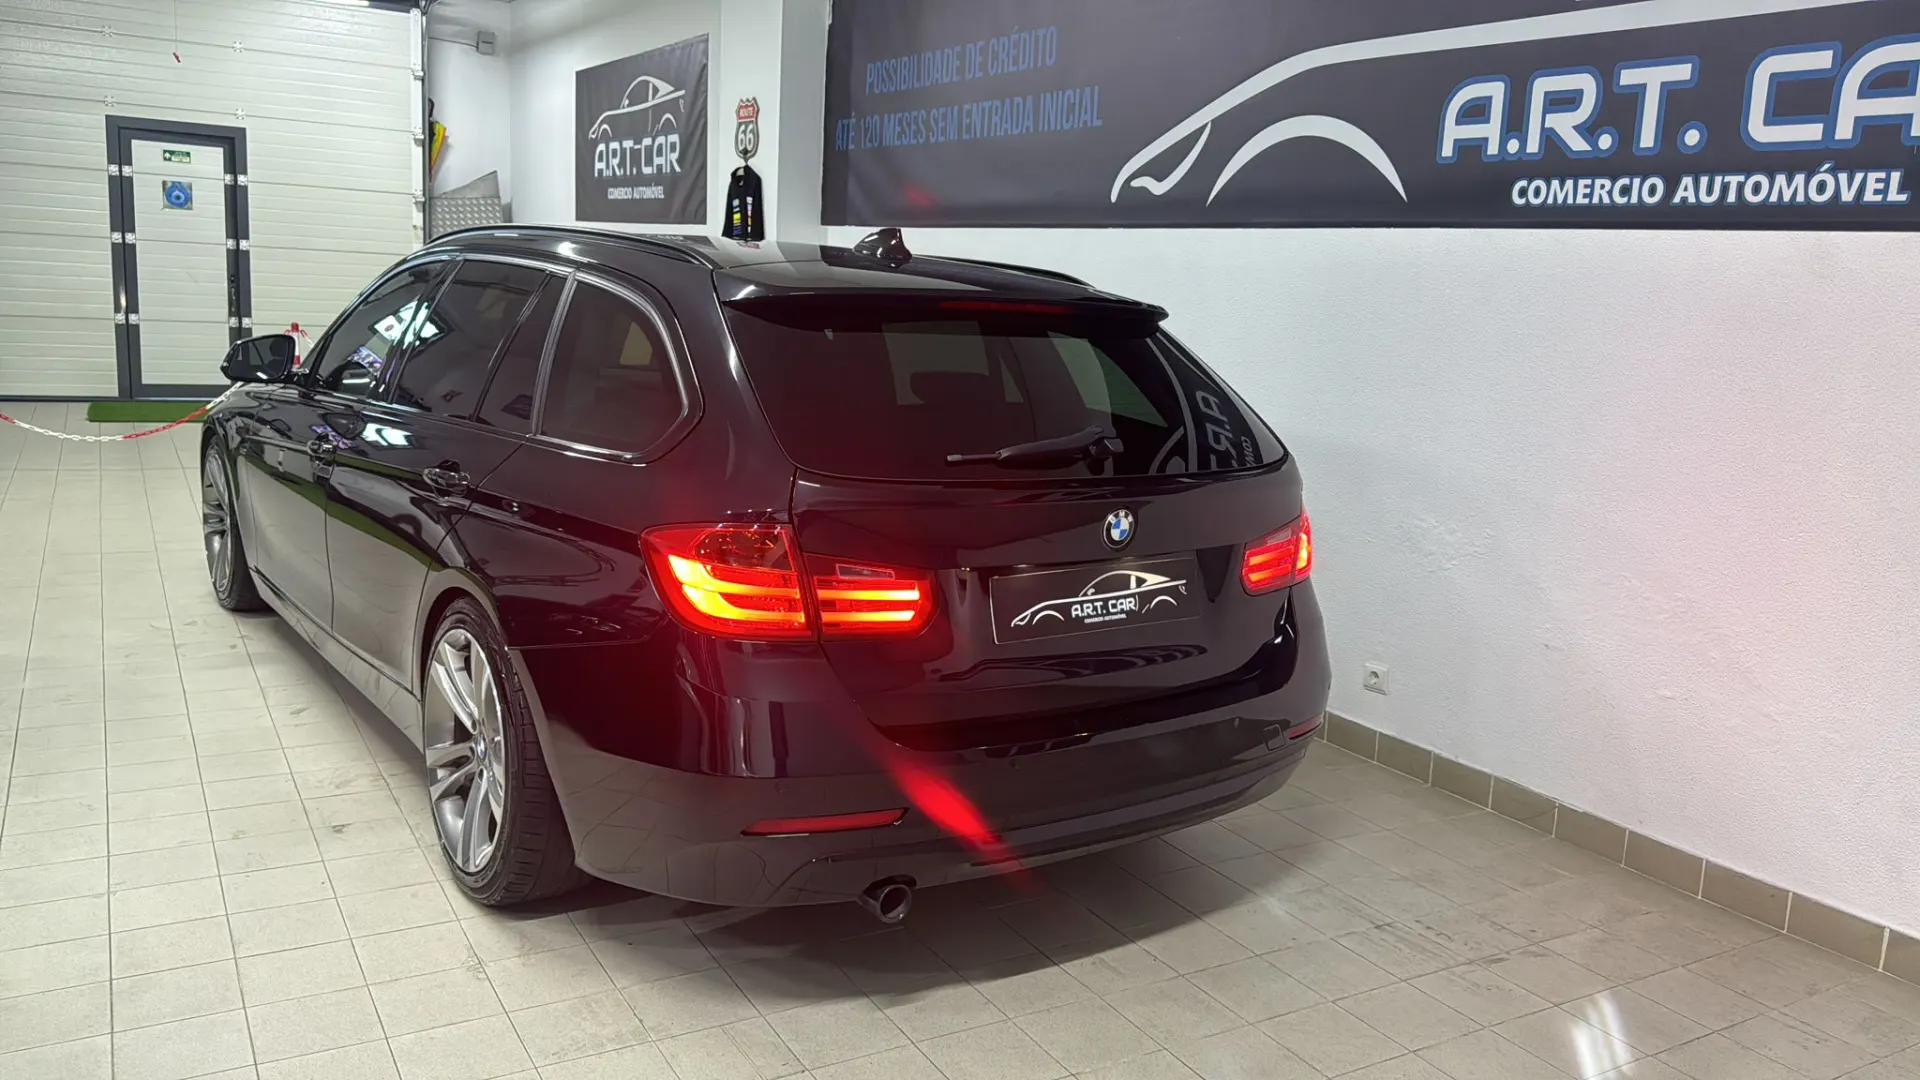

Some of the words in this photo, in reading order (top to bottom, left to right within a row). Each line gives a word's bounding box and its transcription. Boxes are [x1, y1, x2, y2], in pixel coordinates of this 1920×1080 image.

[865, 44, 962, 95] POSSIBILIDADE
[965, 40, 984, 80] DE
[988, 25, 1058, 77] CRÉDITO
[835, 112, 856, 151] ATÉ
[860, 114, 880, 149] 120
[883, 109, 926, 147] MESES
[929, 105, 958, 143] SEM
[962, 95, 1034, 141] ENTRADA
[1039, 85, 1103, 132] INICIAL
[1439, 58, 1704, 160] A.R.T.
[641, 133, 682, 174] CAR
[738, 123, 754, 152] 66
[1512, 176, 1665, 206] COMERCIO
[1671, 162, 1909, 204] AUTOMÓVEL
[1071, 601, 1106, 618] A.R.T.
[1108, 597, 1135, 613] CAR
